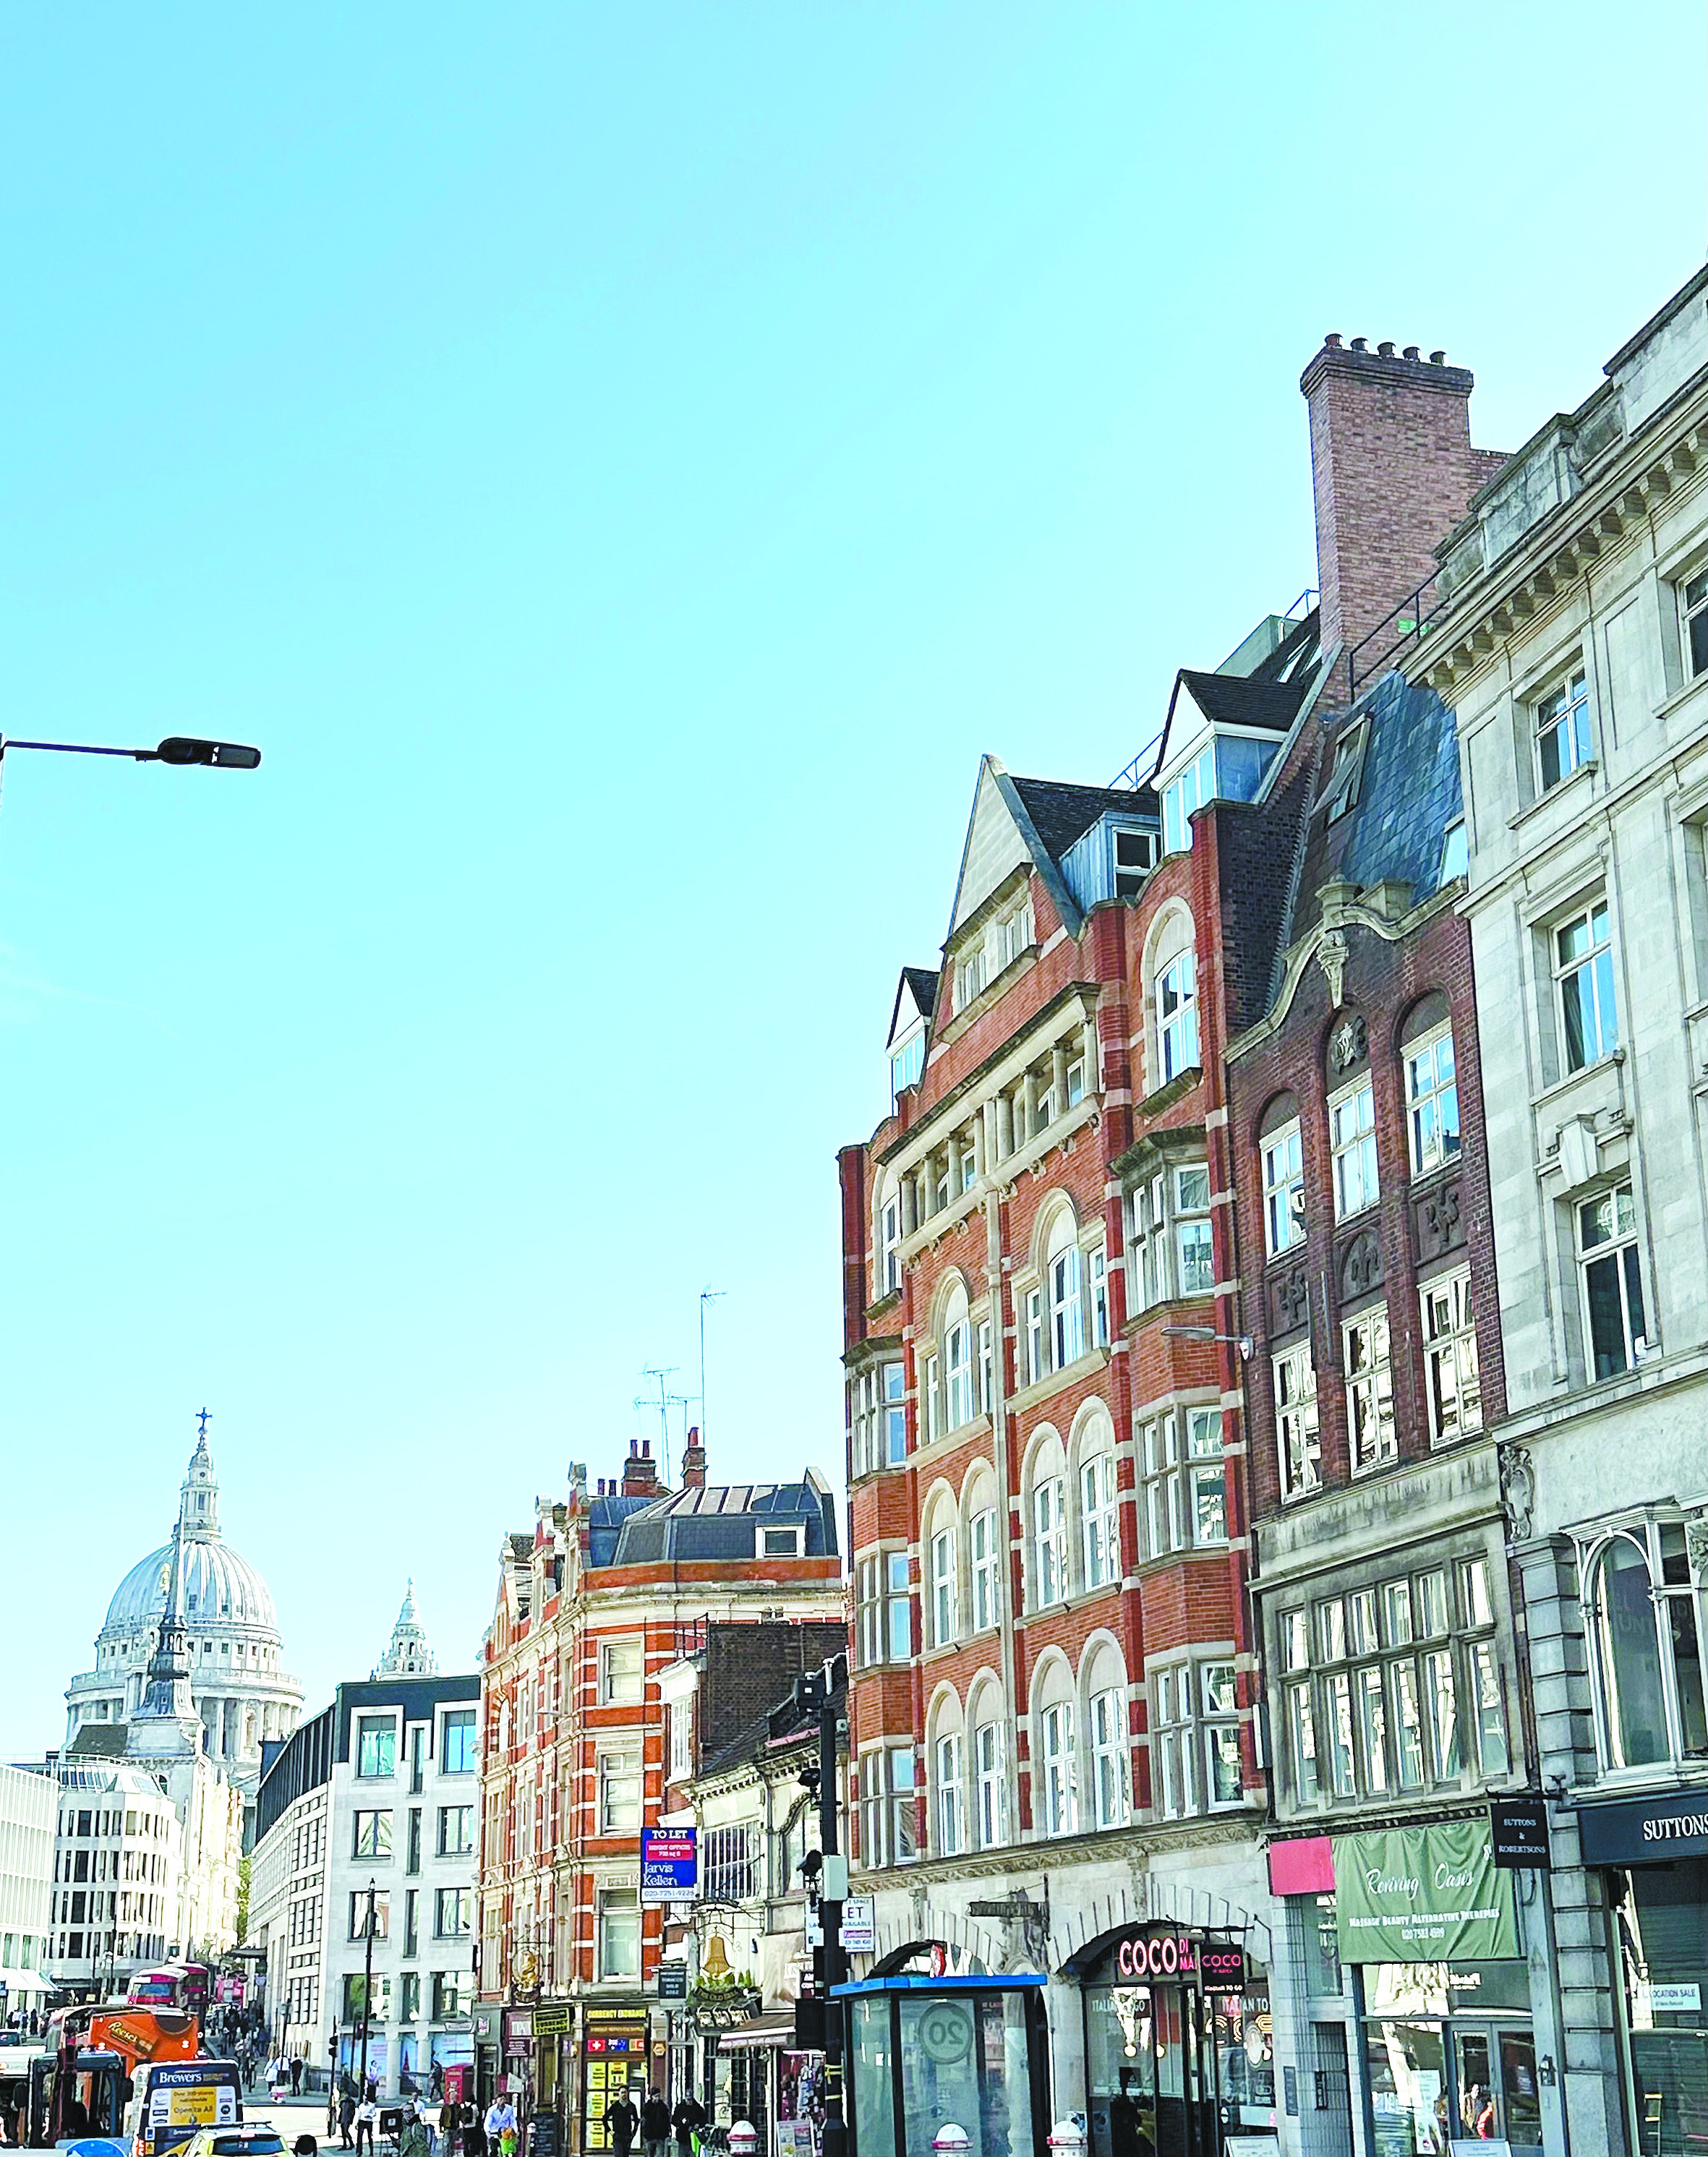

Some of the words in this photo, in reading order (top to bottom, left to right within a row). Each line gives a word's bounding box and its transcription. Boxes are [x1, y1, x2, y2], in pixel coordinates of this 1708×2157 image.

[1503, 1818, 1536, 1827] SUTTONS
[1643, 1814, 1708, 1841] SUTTONS
[652, 1830, 667, 1839] TO
[669, 1830, 688, 1839] LET
[644, 1862, 673, 1874] Jarvis
[1435, 1861, 1474, 1890] Oasis
[1119, 1937, 1177, 1976] COCO
[1179, 1939, 1189, 1953] DI
[1202, 1955, 1241, 1967] COCO
[159, 2072, 202, 2083] Brewers
